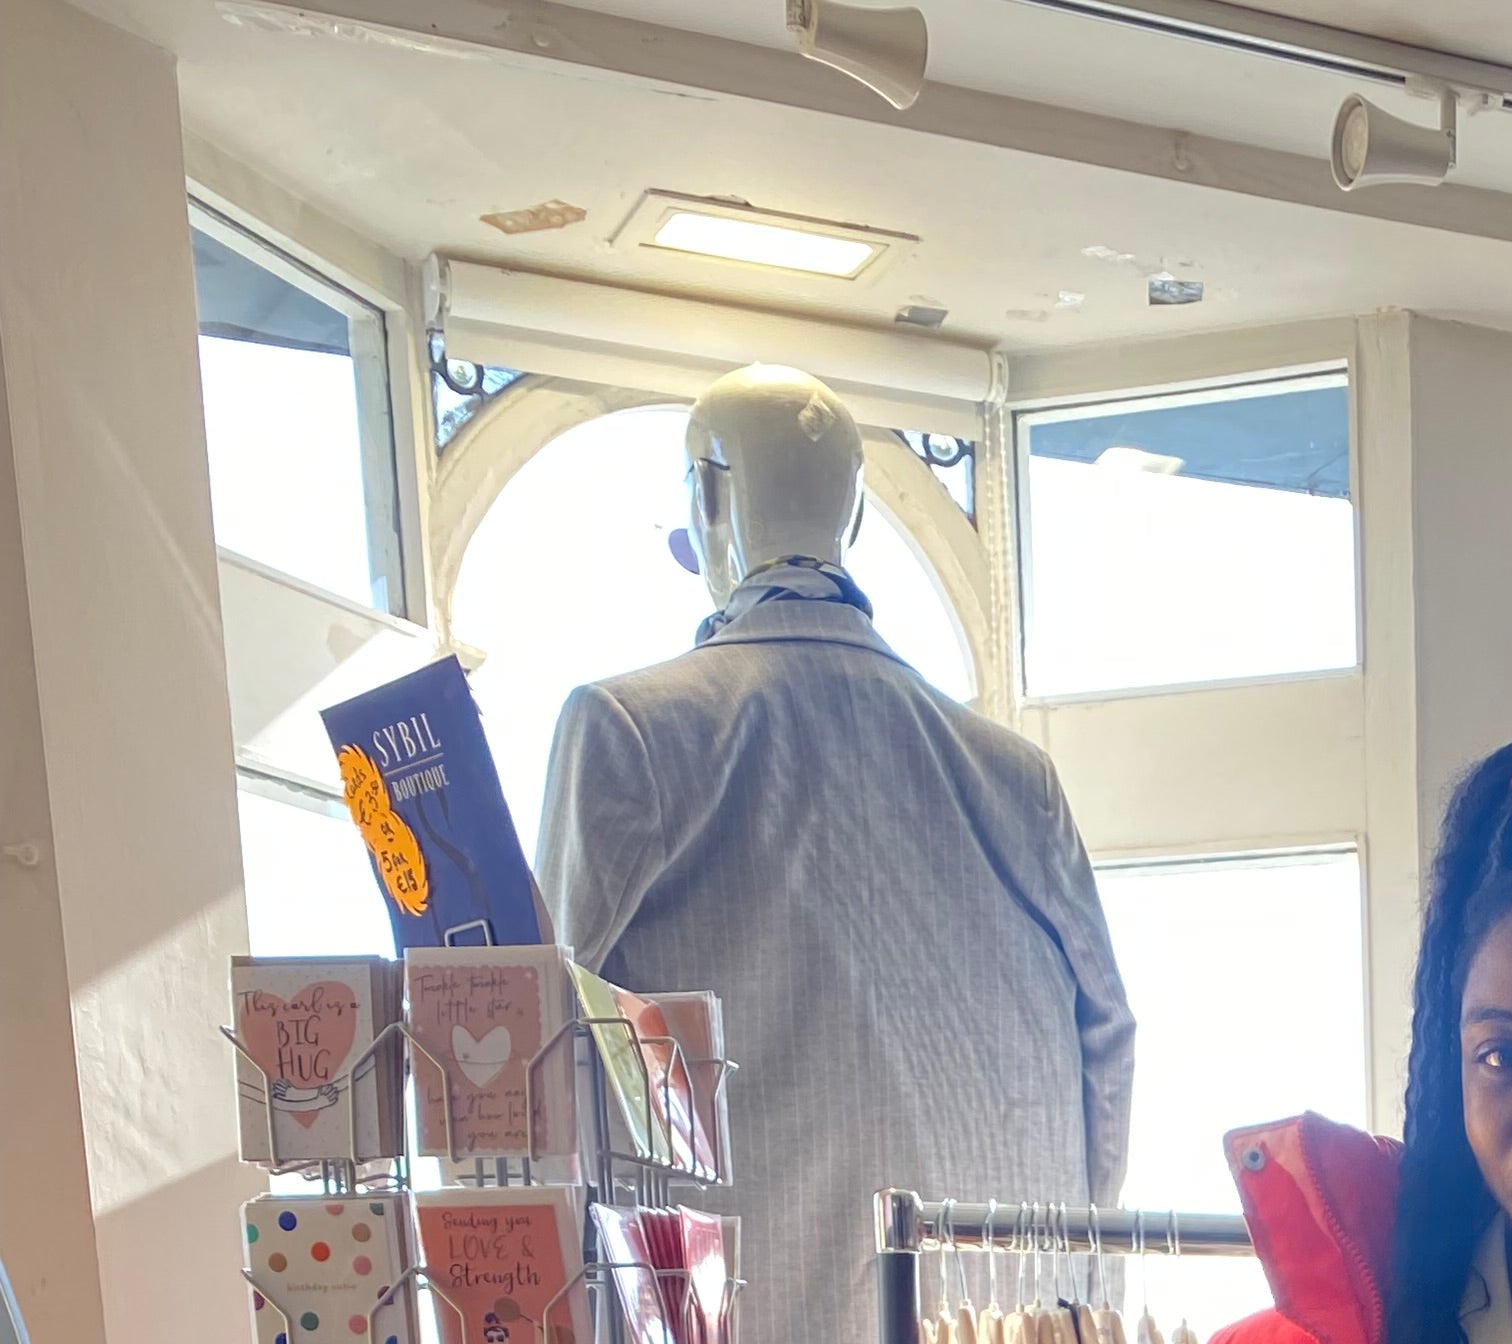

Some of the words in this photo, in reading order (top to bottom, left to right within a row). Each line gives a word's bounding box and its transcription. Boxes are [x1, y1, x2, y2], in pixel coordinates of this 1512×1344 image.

[372, 712, 441, 768] SYBIL
[391, 763, 450, 802] BOUTIQUE
[276, 1015, 321, 1048] BIG
[276, 1047, 331, 1082] HUG
[442, 1211, 498, 1234] Sending
[505, 1215, 531, 1233] you
[448, 1234, 510, 1261] LOVE
[522, 1233, 536, 1260] &
[449, 1260, 541, 1295] Strength
